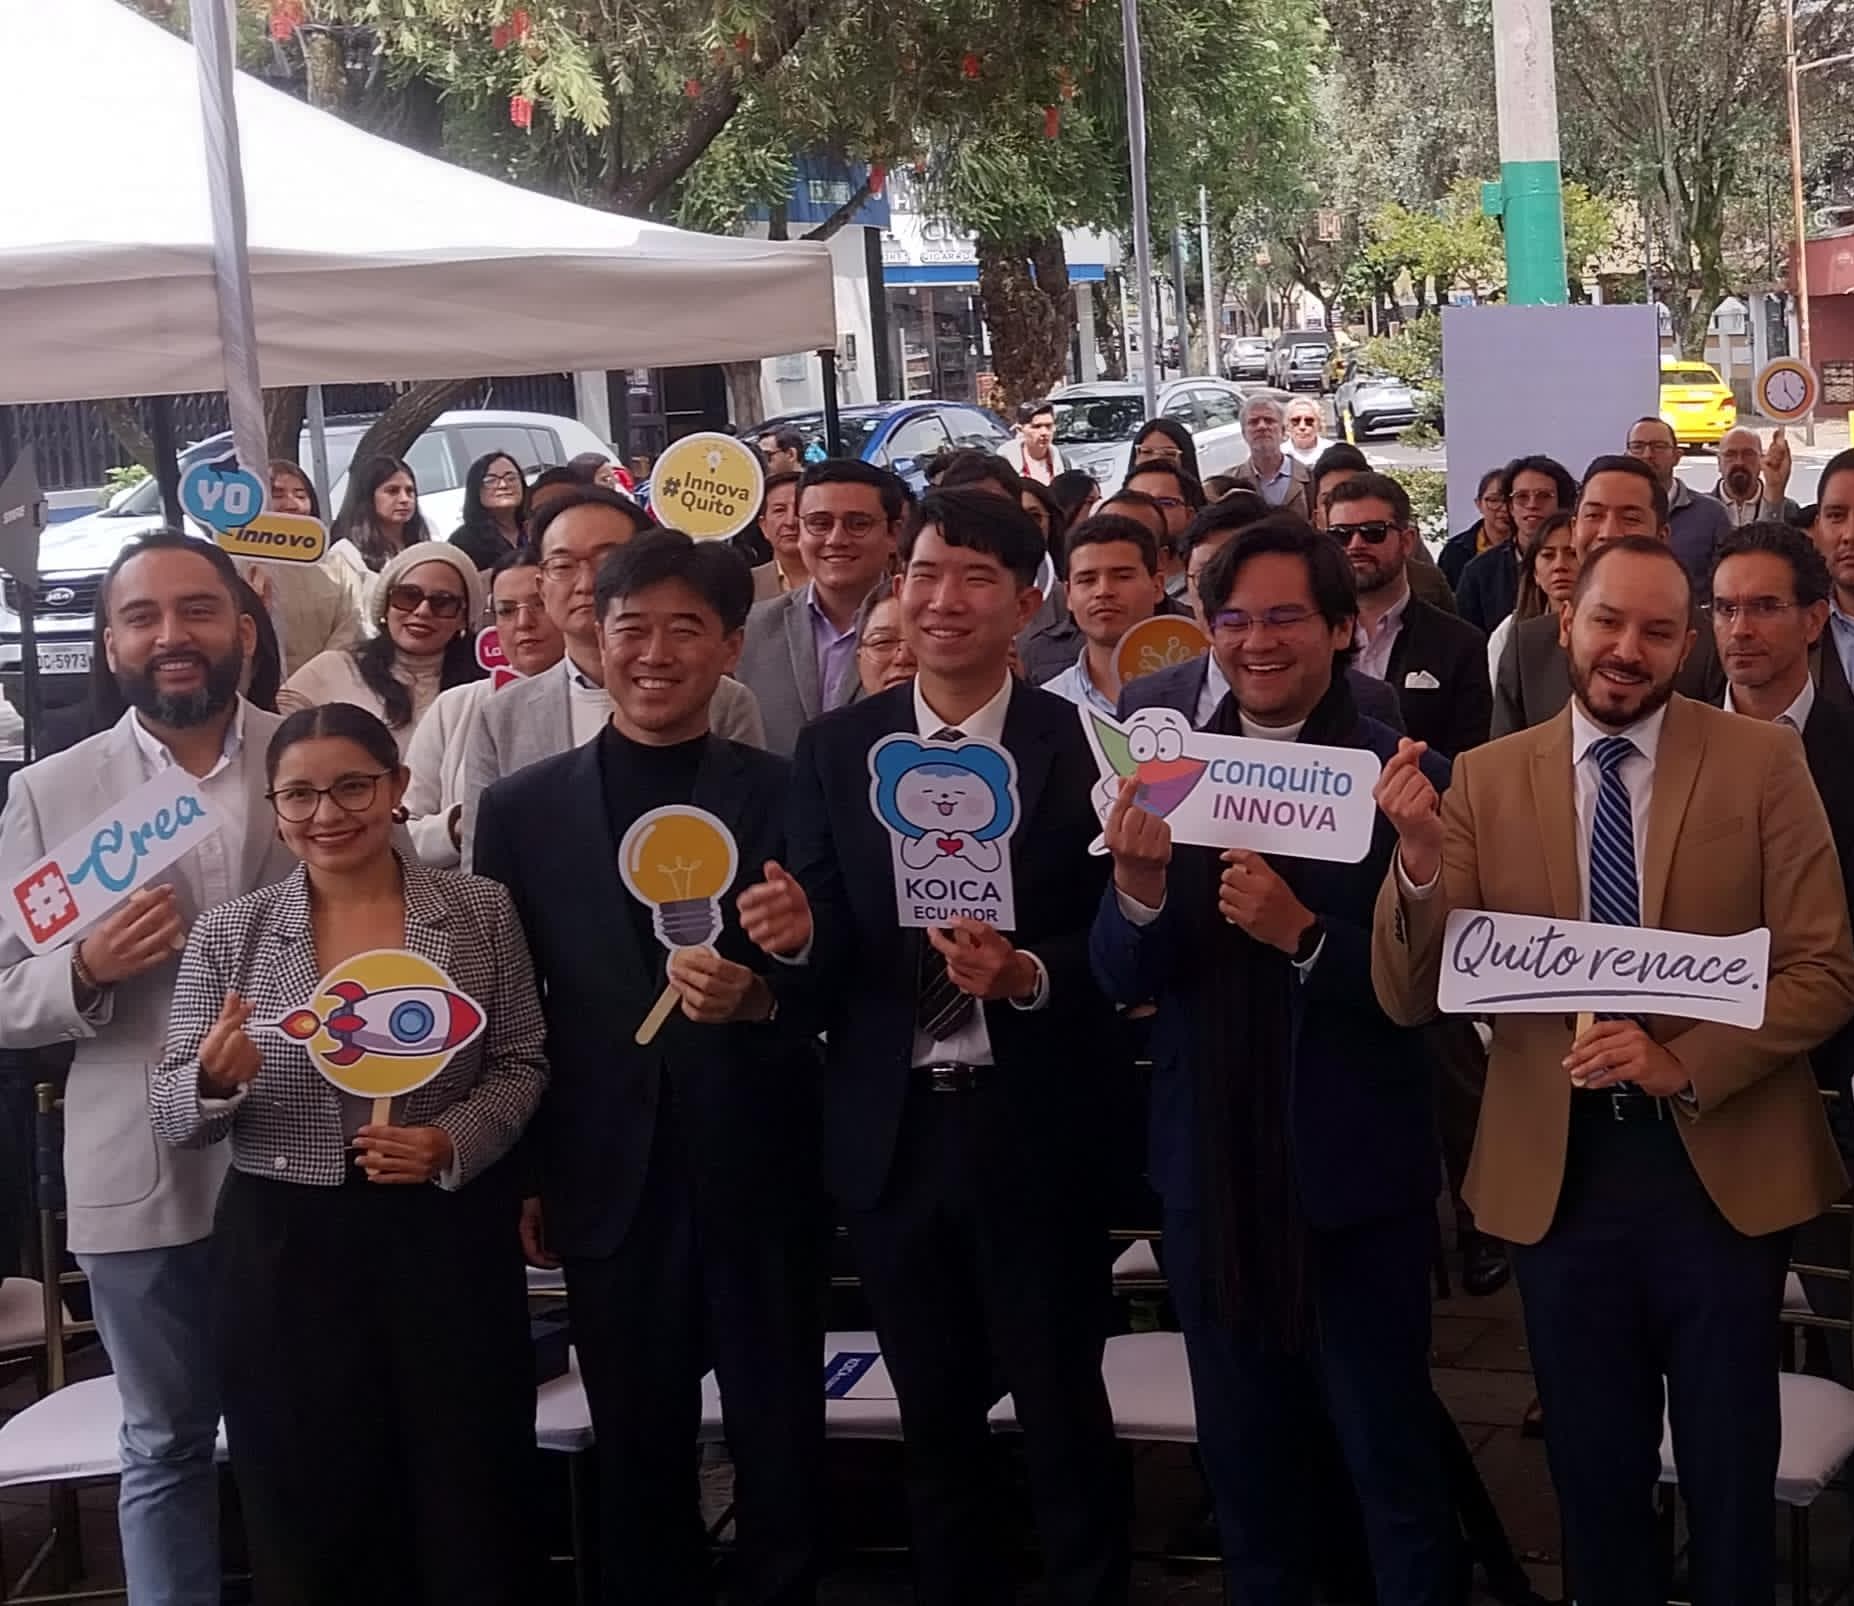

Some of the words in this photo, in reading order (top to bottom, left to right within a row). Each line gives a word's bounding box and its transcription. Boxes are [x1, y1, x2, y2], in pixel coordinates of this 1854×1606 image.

[198, 479, 250, 514] YO
[681, 490, 734, 516] Quito
[236, 528, 316, 549] innovo
[1210, 758, 1353, 797] conquito
[1212, 793, 1337, 832] INNOVA
[905, 878, 1002, 902] KOICA
[914, 906, 998, 922] ECUADOR
[1453, 915, 1584, 979] Quito
[1588, 945, 1759, 990] renace.
